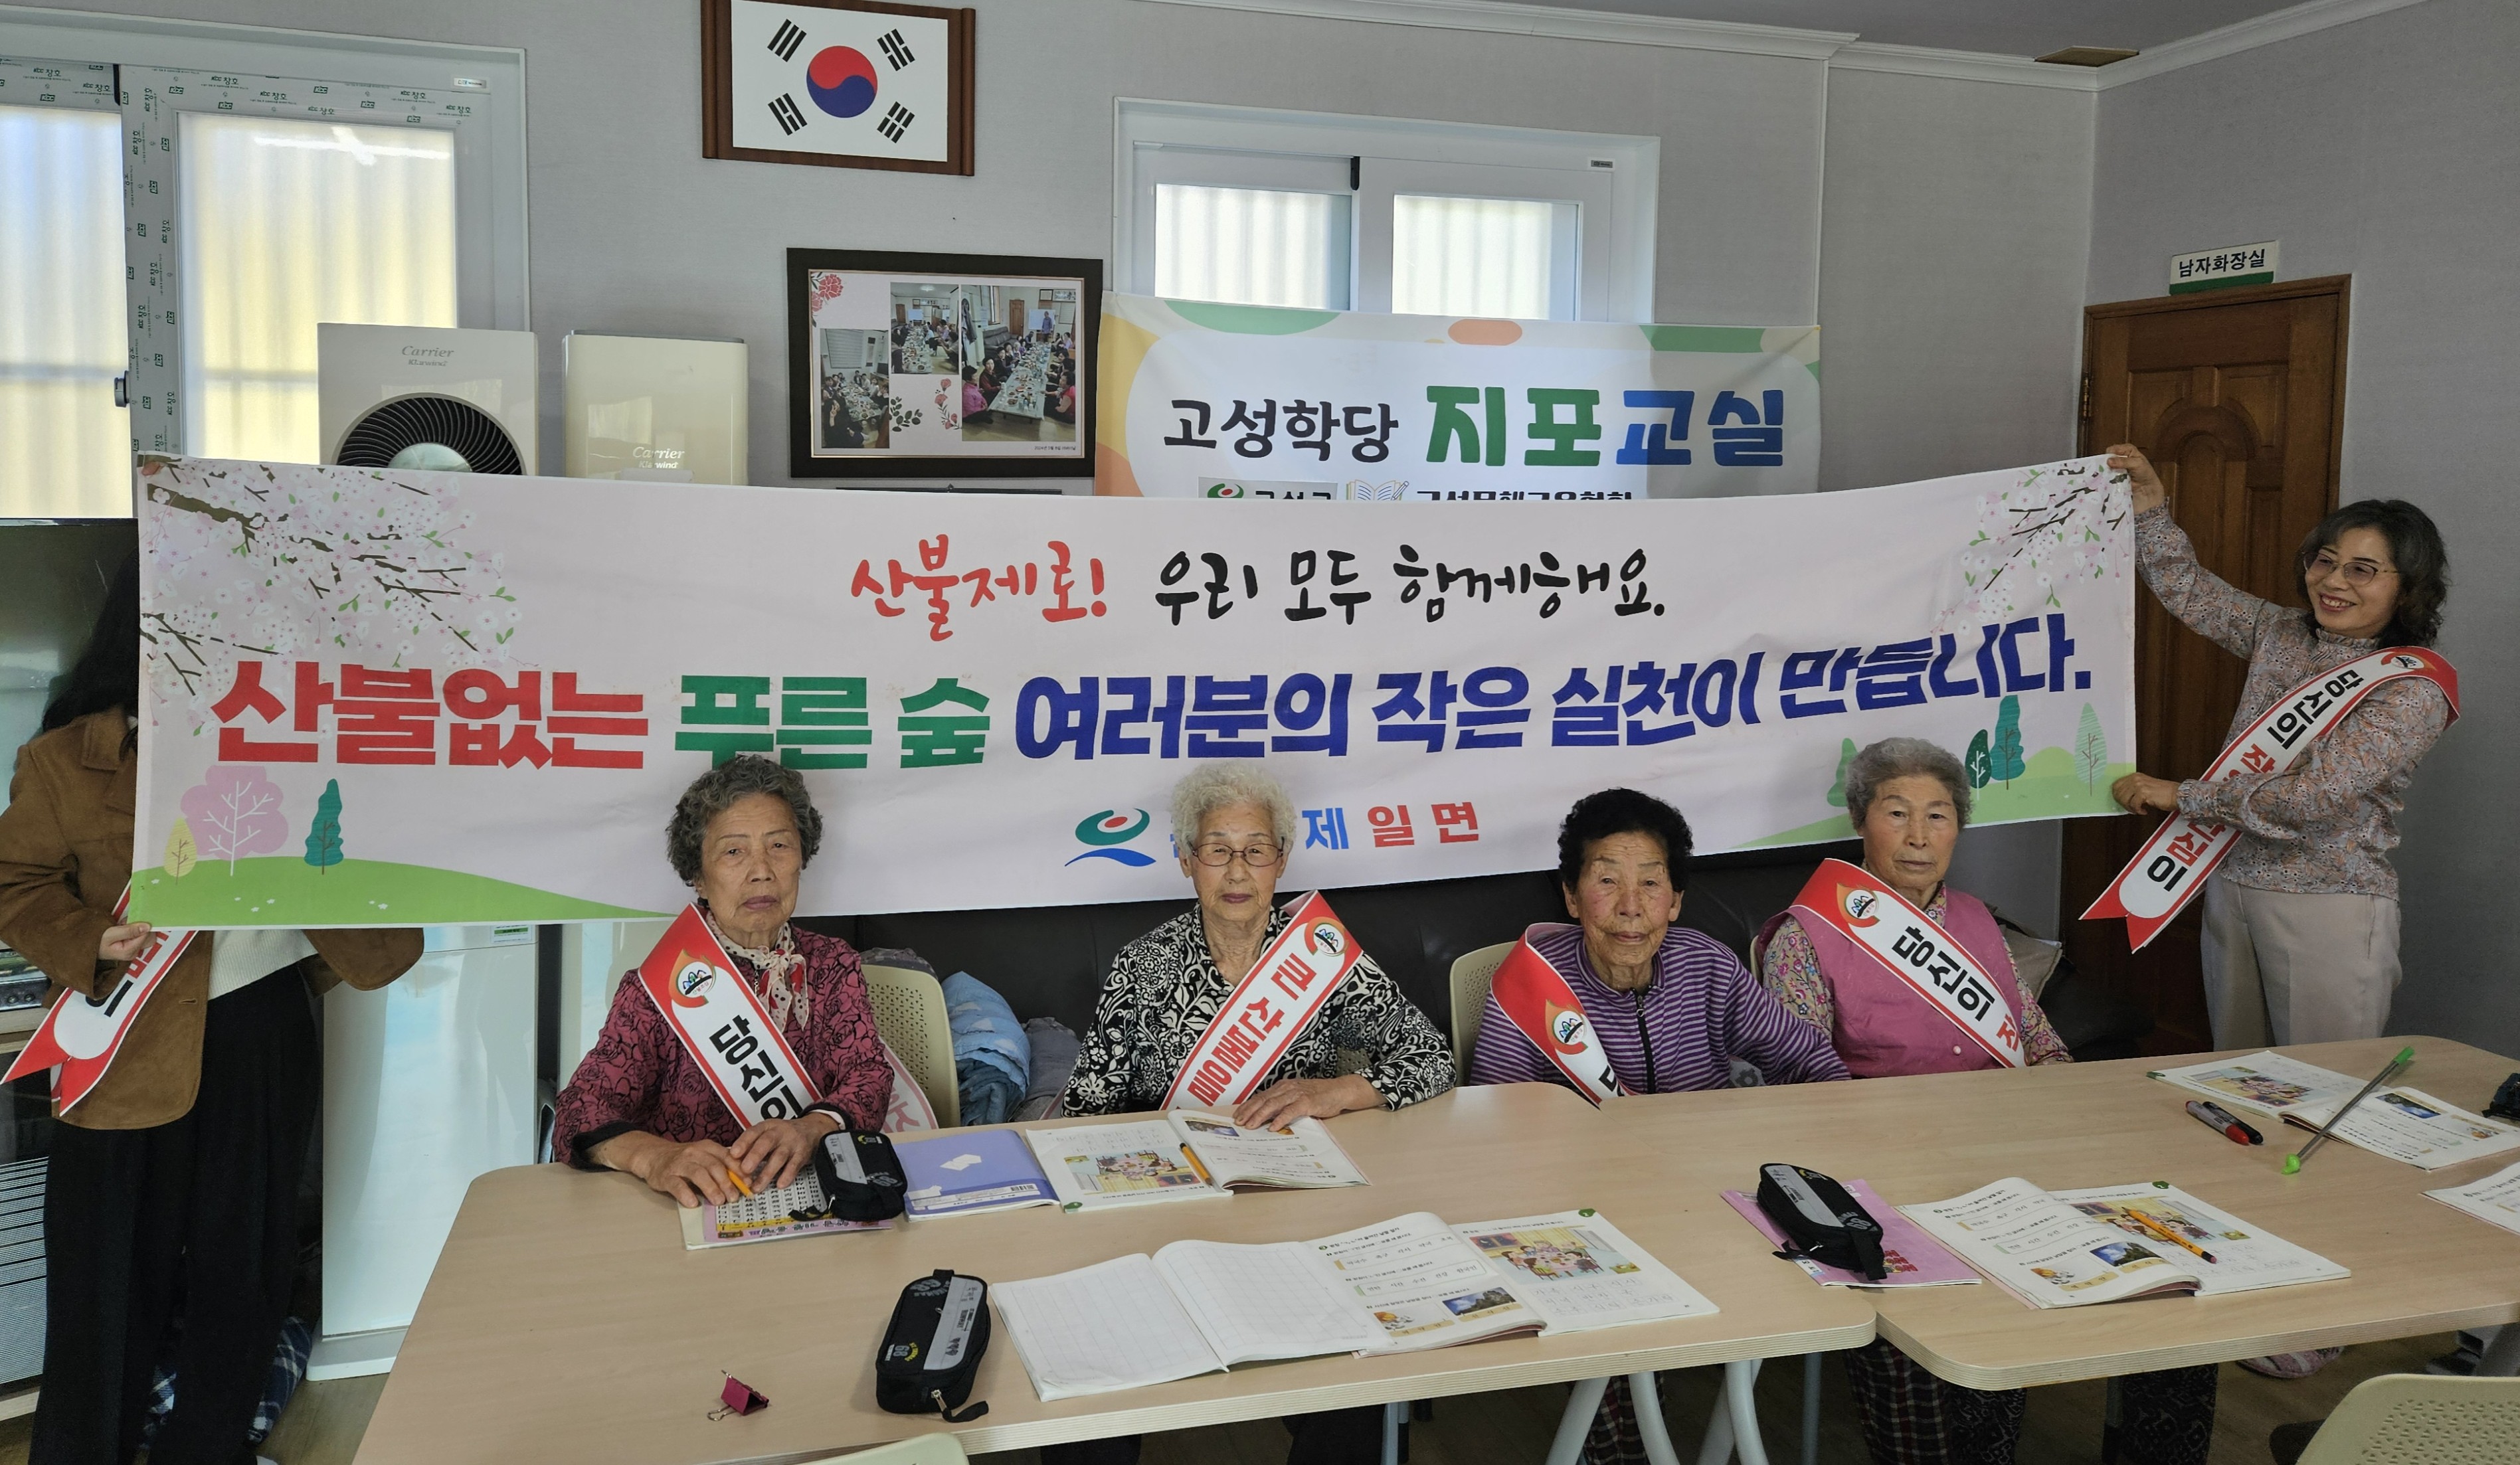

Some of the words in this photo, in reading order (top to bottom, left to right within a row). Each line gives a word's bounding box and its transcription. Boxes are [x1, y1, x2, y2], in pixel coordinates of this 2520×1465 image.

[2179, 249, 2265, 278] 남자화장실
[401, 345, 454, 357] Carrier
[633, 446, 685, 459] Carrier
[1164, 399, 1398, 462] 고성학당
[1429, 388, 1599, 466] 지포
[1616, 390, 1783, 466] 교실
[852, 535, 1106, 641] 산불제로!
[1156, 551, 1257, 626] 우리
[1289, 550, 1371, 625] 모두
[1394, 545, 1665, 622] 함께해요.
[212, 661, 648, 768] 산불없는
[676, 676, 871, 769] 푸른
[899, 679, 989, 768] 숲
[1016, 673, 1352, 759] 여러분의
[1373, 667, 1530, 752] 작은
[1552, 653, 1764, 746] 실천이
[1780, 614, 2090, 719] 만듭니다.
[2266, 669, 2364, 750] 당신의
[1271, 952, 1317, 1001] 큰
[1891, 926, 1995, 1022] 당신의
[709, 1014, 804, 1120] 당신의
[1187, 996, 1285, 1107] 산불을
